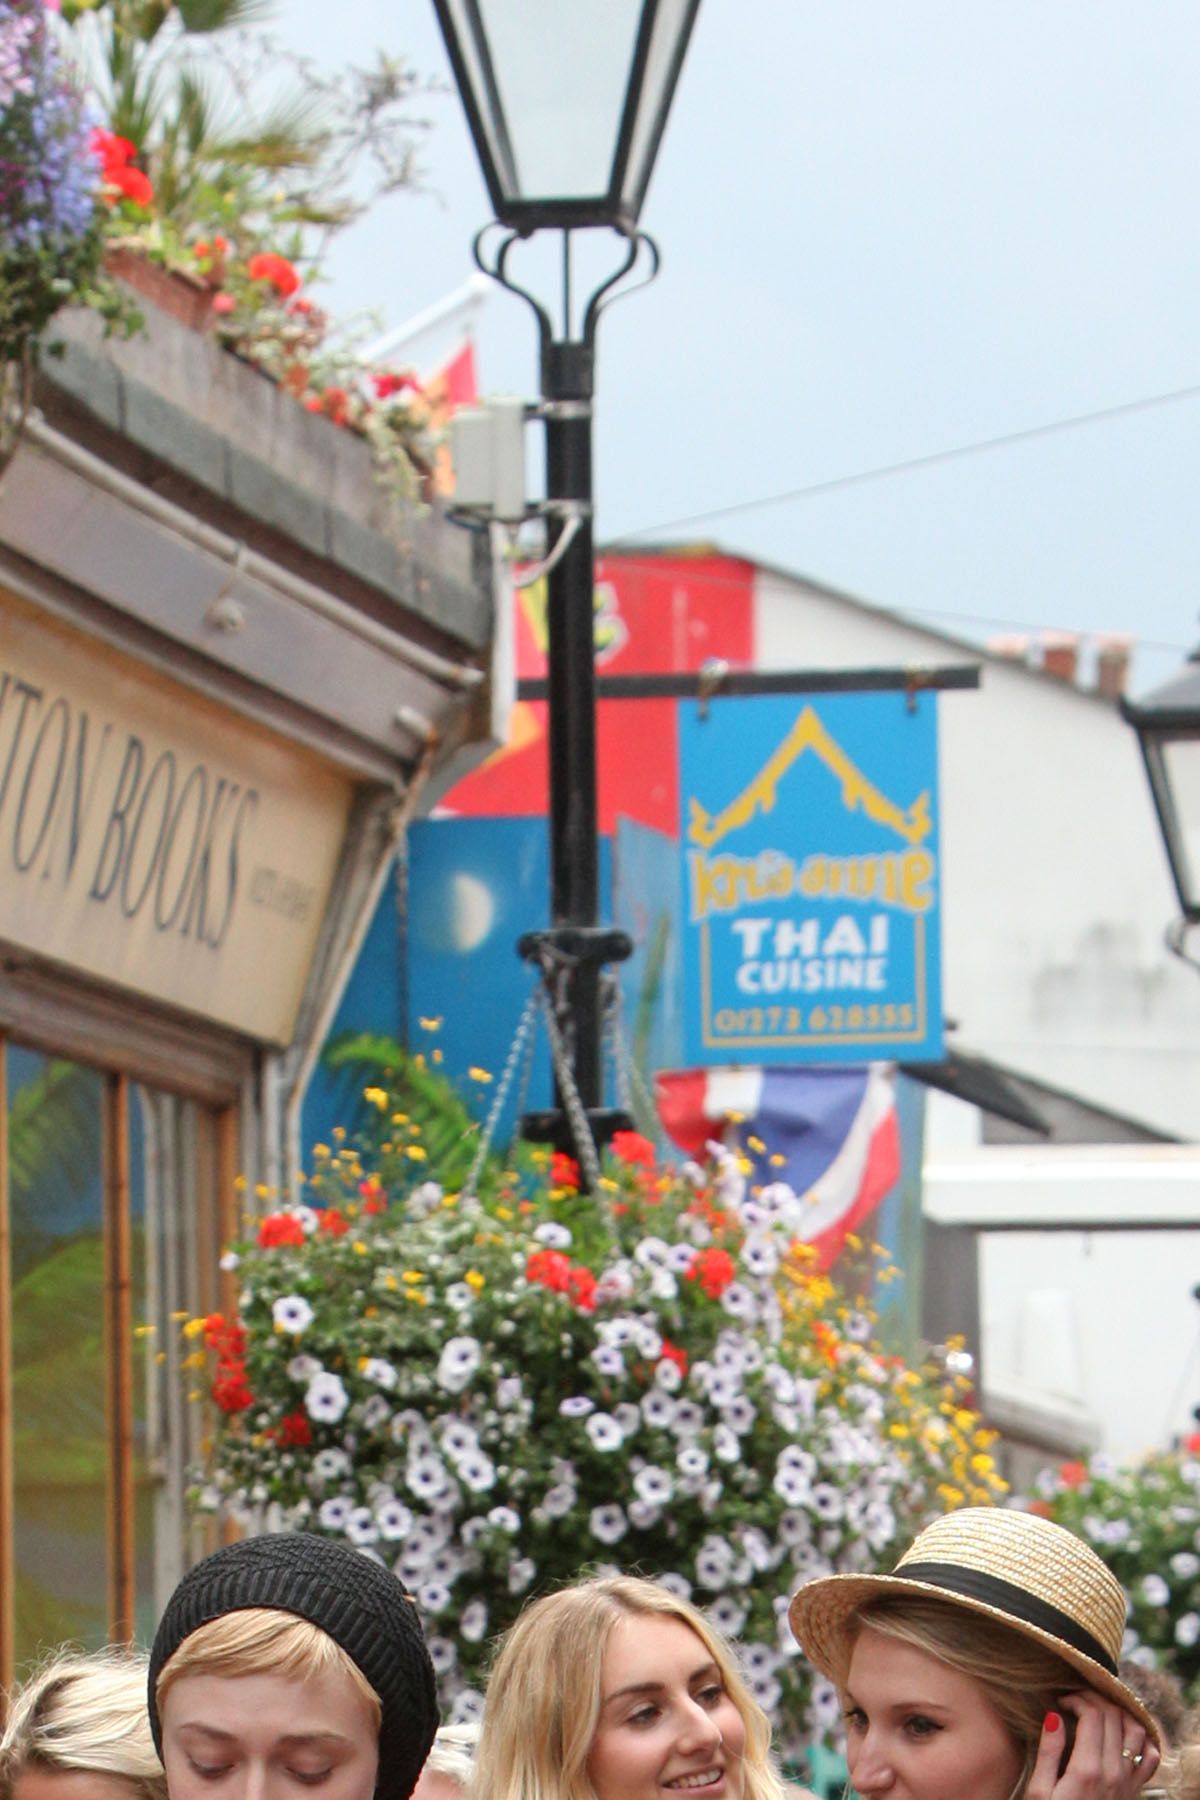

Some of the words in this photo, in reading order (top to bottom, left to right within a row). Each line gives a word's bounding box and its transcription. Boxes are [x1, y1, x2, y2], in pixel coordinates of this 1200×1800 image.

[89, 734, 259, 950] BOOKS
[731, 913, 890, 958] THAI
[736, 957, 888, 994] CUISINE
